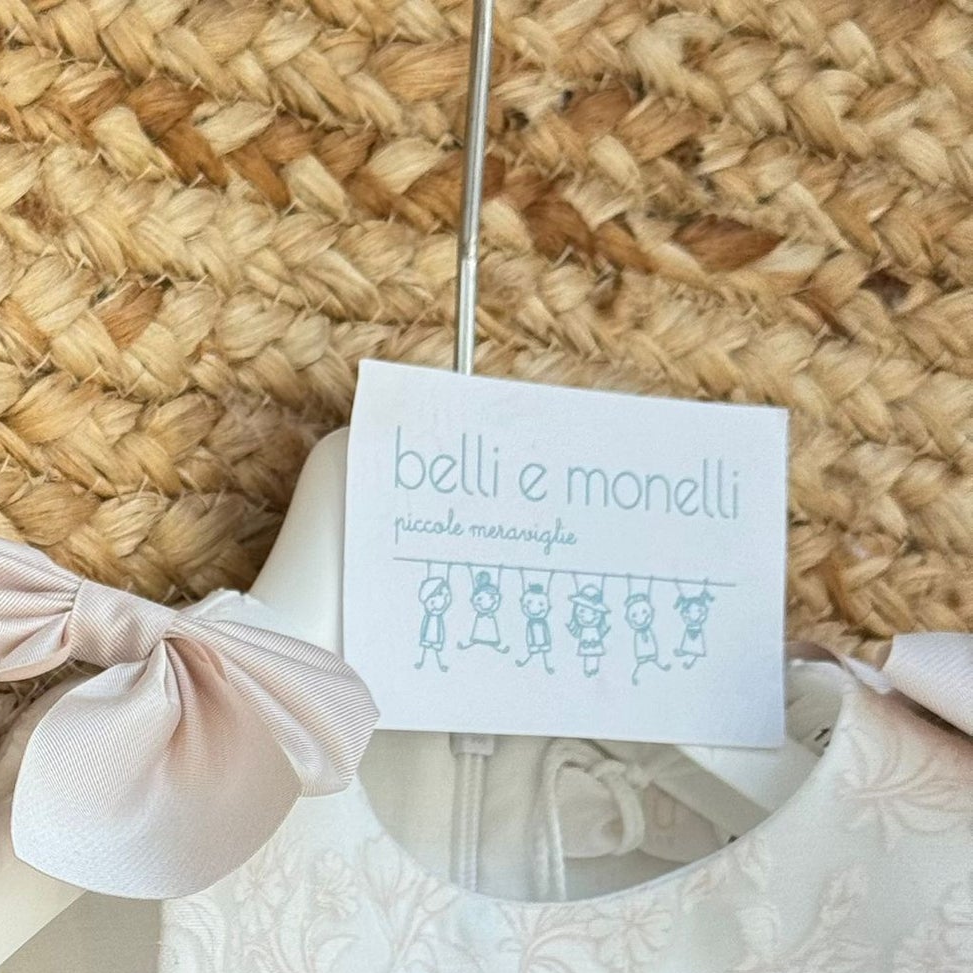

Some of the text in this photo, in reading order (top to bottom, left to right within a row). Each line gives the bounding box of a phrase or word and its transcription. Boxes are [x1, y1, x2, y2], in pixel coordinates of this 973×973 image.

[394, 425, 740, 520] belli e monelli
[394, 507, 578, 556] piccole meraviglie
